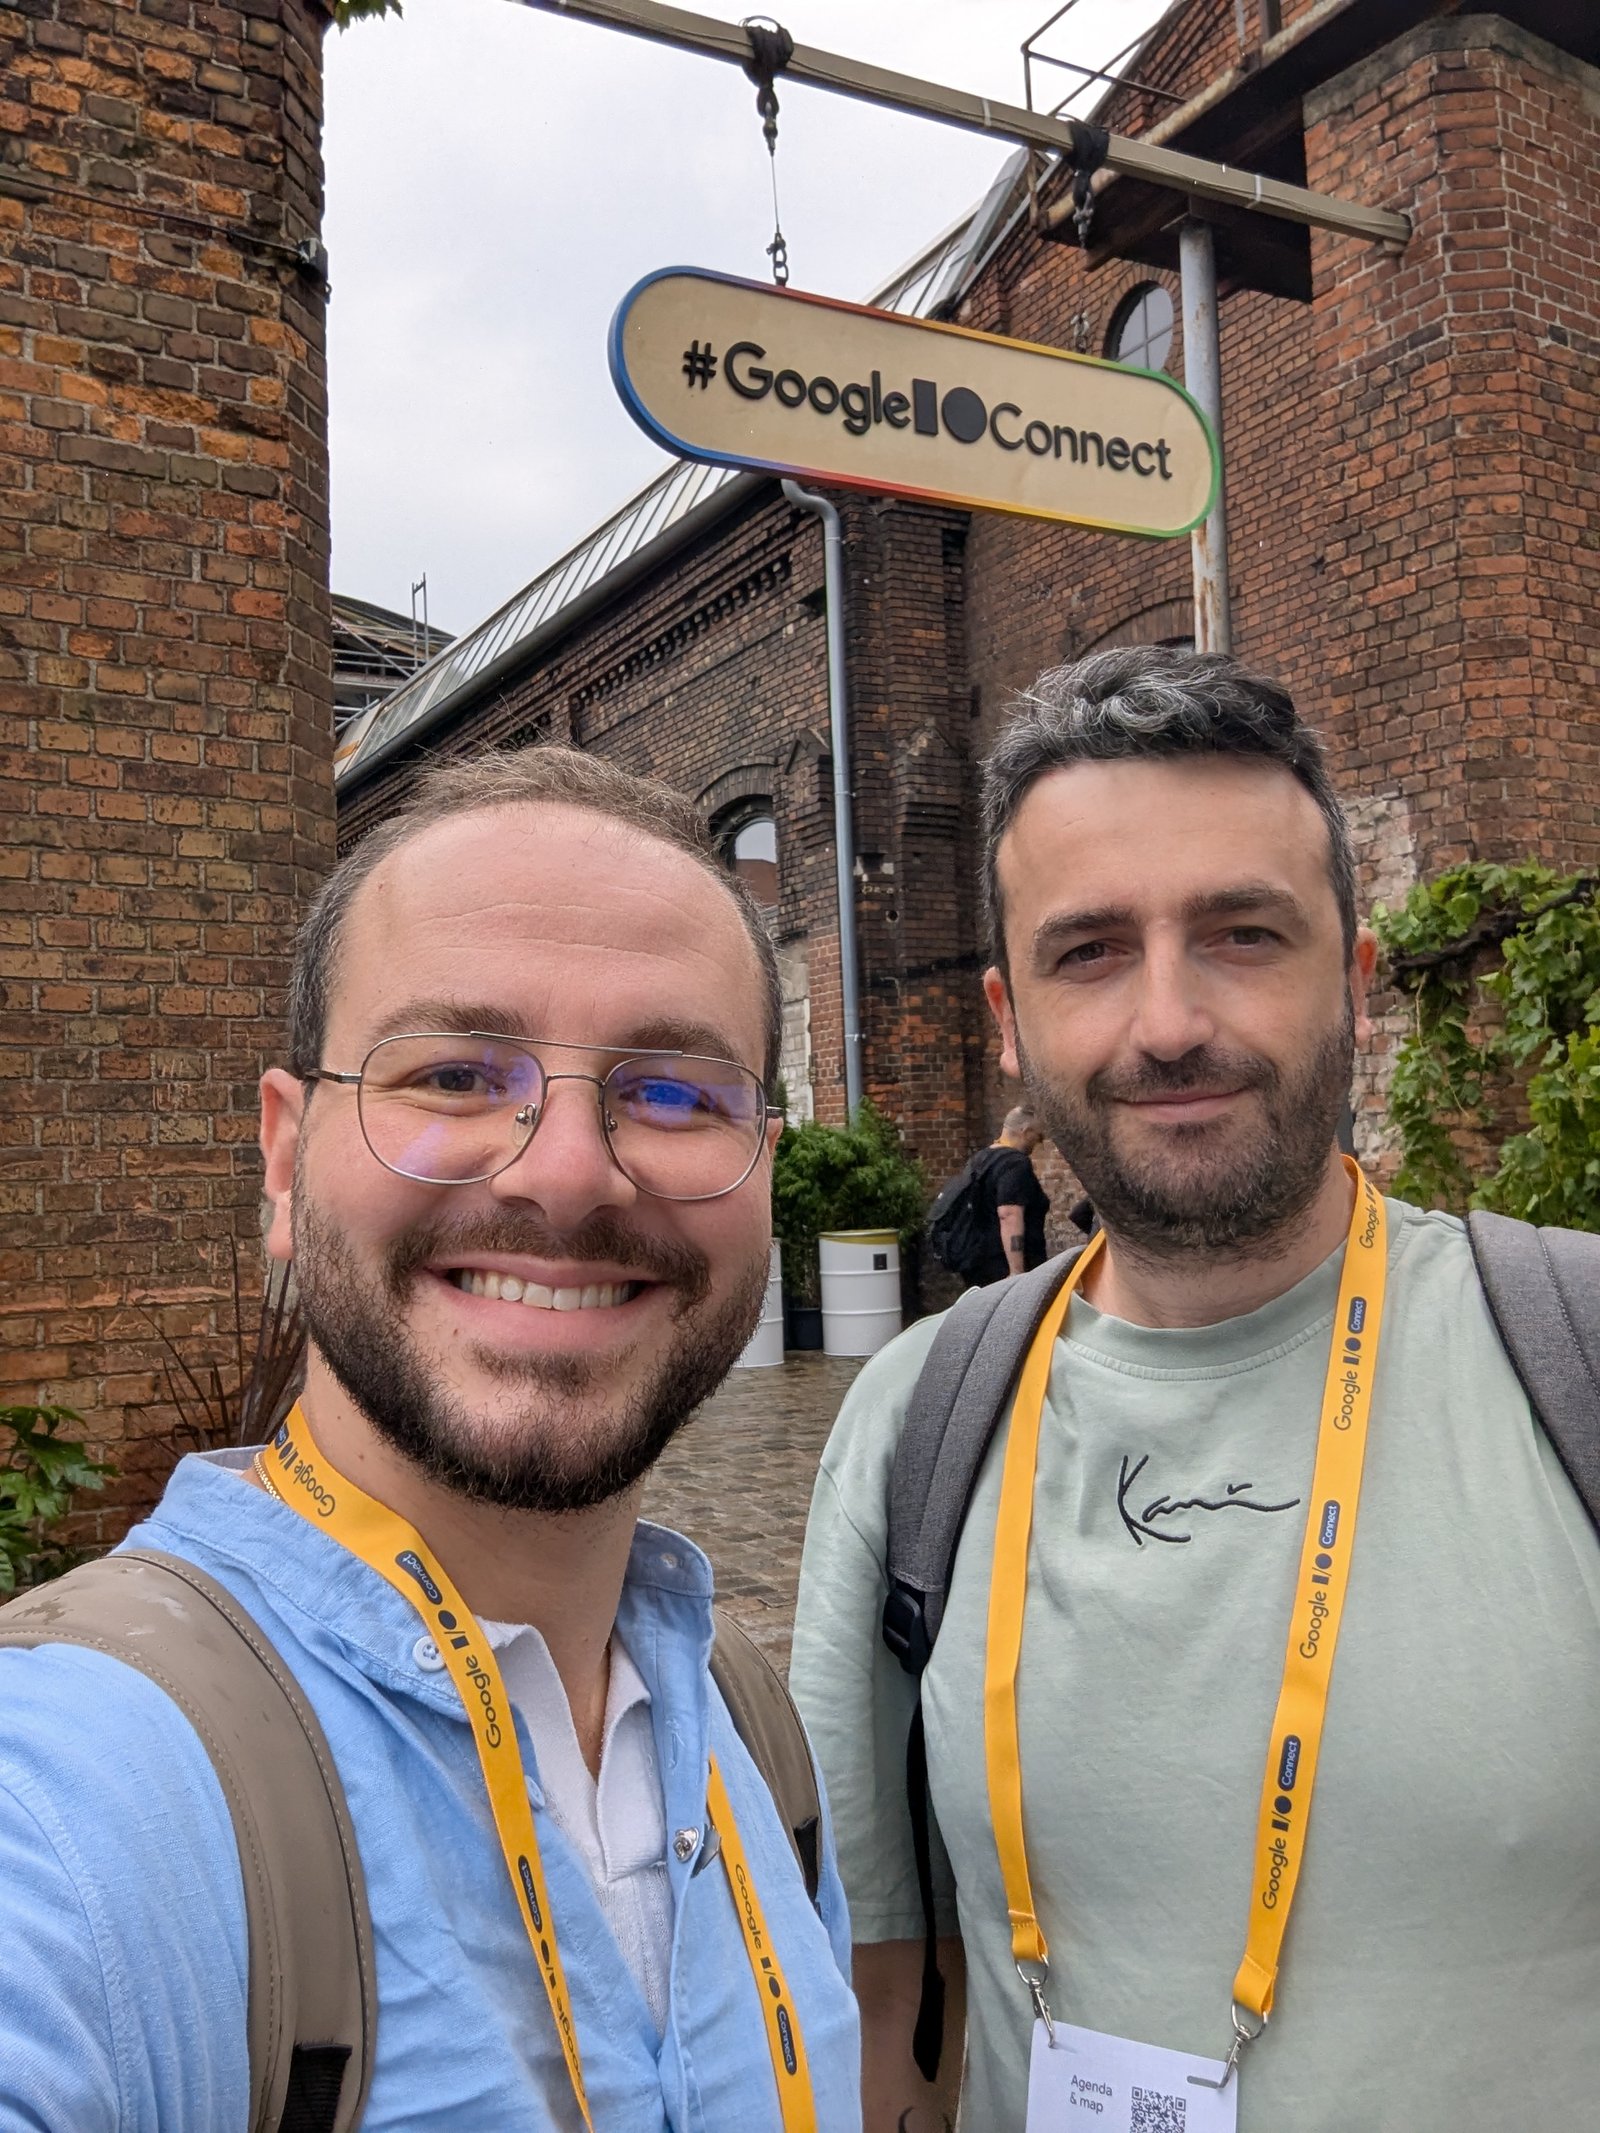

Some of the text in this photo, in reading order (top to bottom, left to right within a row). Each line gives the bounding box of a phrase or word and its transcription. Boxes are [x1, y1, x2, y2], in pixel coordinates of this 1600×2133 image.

[1359, 1206, 1380, 1249] Google
[1334, 1370, 1361, 1431] Google
[1351, 1300, 1364, 1331] Connect
[293, 1460, 336, 1517] Google
[402, 1553, 438, 1600] Connect
[1299, 1590, 1330, 1659] Google
[1321, 1505, 1338, 1545] Connect
[465, 1654, 502, 1749] Google
[1262, 1837, 1288, 1910] Google
[1281, 1740, 1299, 1786] Connect
[521, 1862, 541, 1925] Connect
[735, 1864, 762, 1950] Google
[778, 2010, 794, 2068] Connect
[1069, 2092, 1104, 2115] & map
[1070, 2074, 1113, 2097] Agenda
